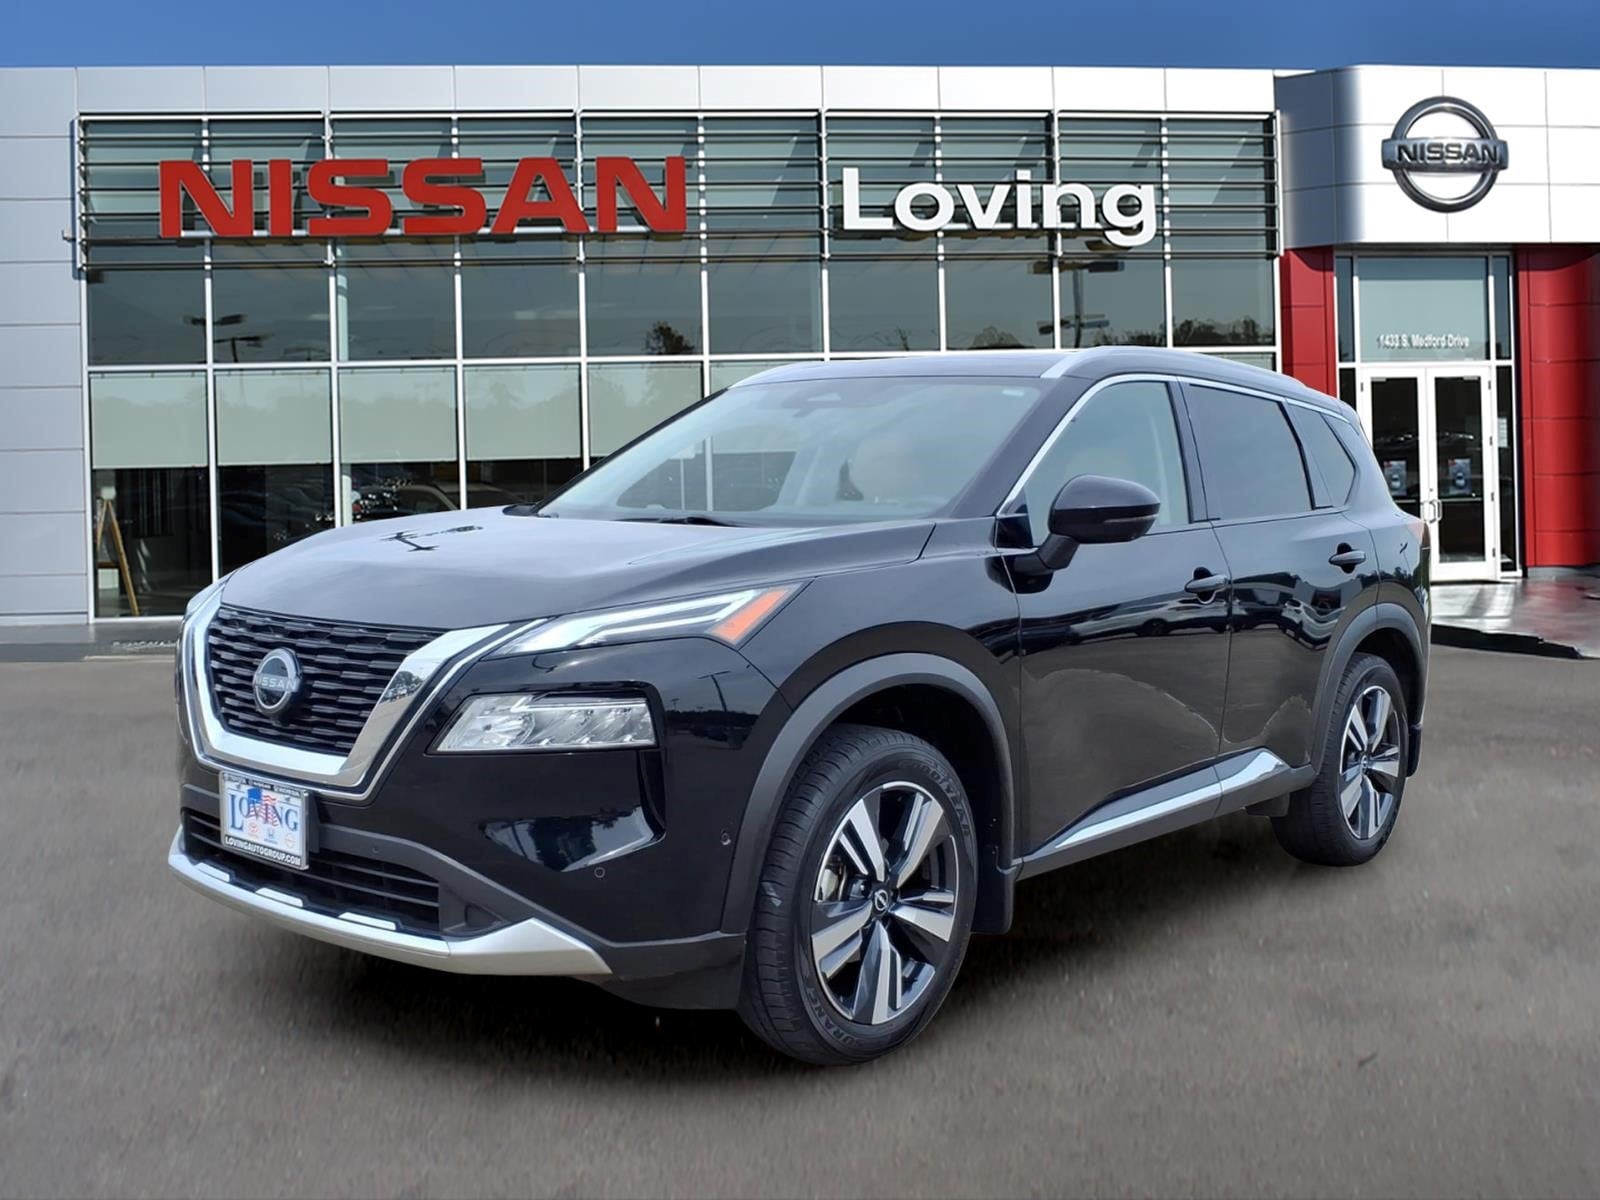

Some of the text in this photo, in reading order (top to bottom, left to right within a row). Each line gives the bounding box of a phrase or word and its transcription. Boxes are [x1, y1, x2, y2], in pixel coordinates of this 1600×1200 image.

[1397, 142, 1498, 163] NISSAN
[159, 156, 687, 238] NISSAN
[842, 167, 1157, 247] Loving
[1447, 333, 1470, 348] Drive
[229, 793, 299, 832] LOVING
